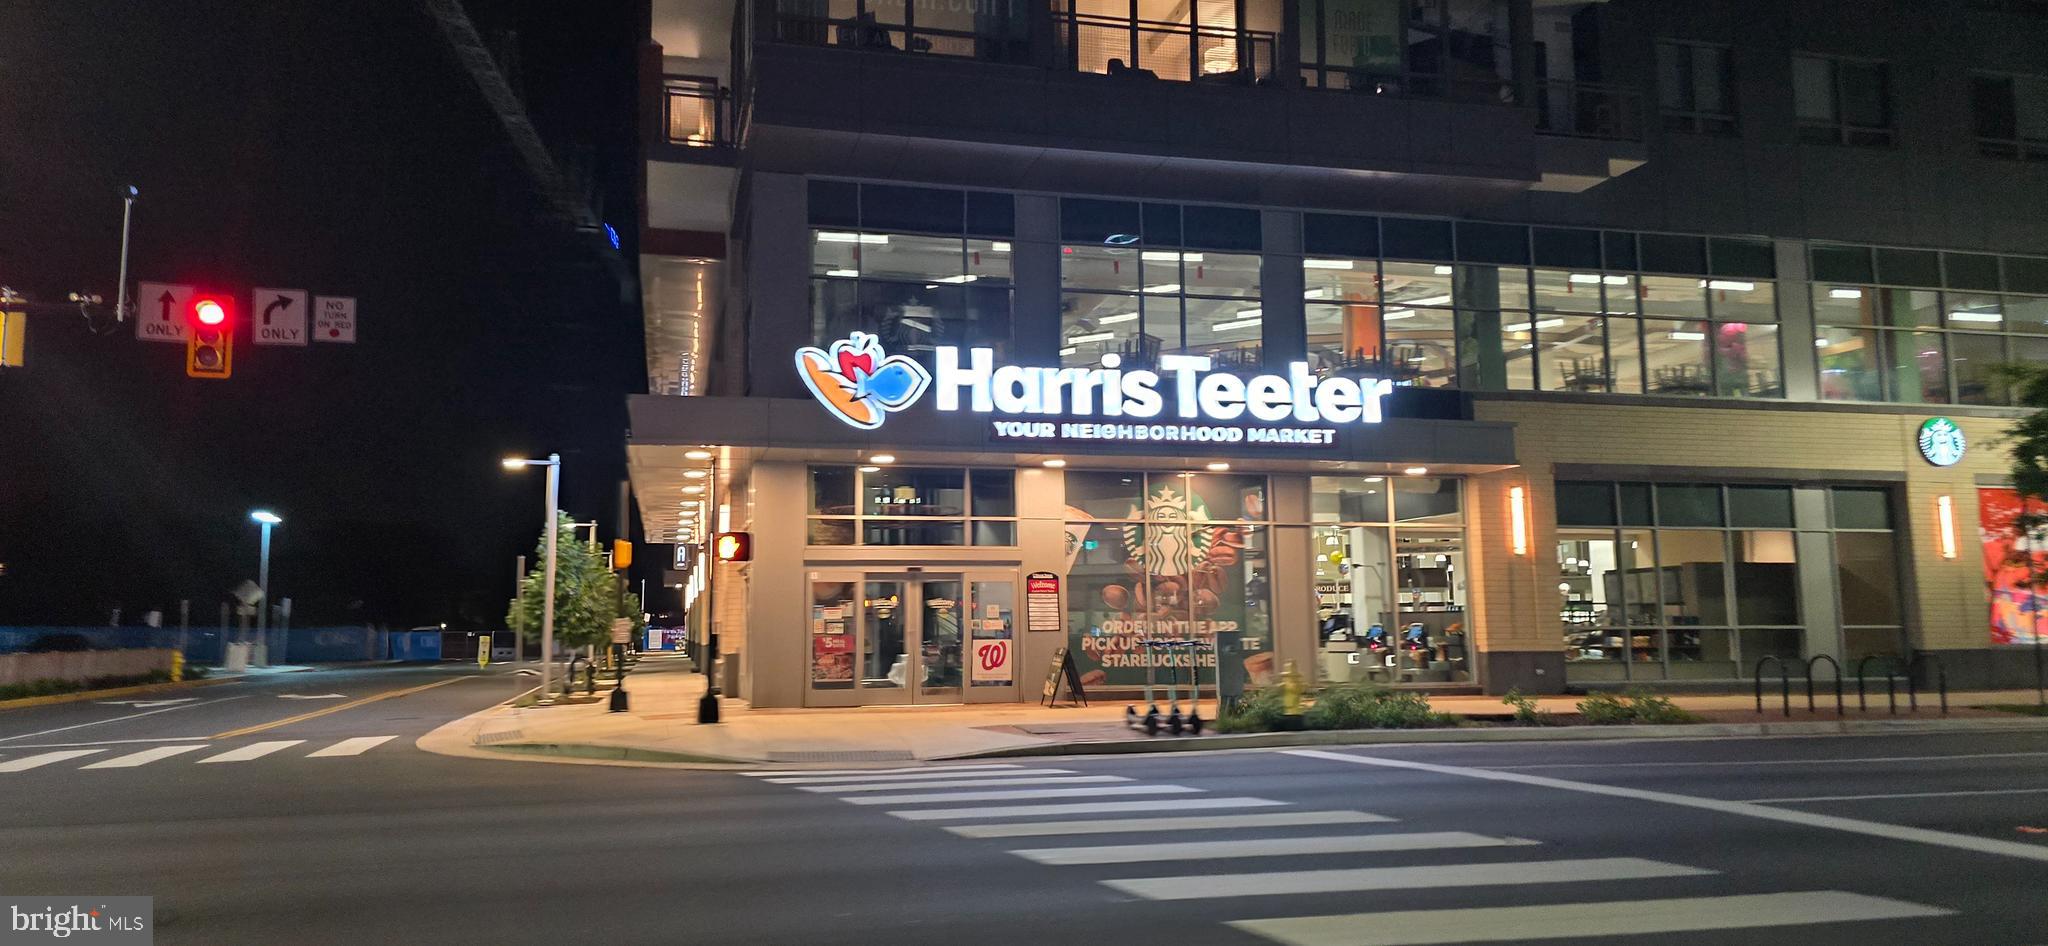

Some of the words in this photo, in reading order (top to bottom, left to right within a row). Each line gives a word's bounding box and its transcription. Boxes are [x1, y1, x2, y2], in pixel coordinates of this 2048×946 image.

[326, 301, 344, 310] NO
[324, 311, 347, 320] TURN
[146, 325, 183, 337] ONLY
[318, 320, 329, 328] ON
[334, 321, 352, 330] RED
[261, 327, 299, 340] ONLY
[936, 346, 1162, 418] Harris
[1161, 355, 1393, 424] Teeter
[993, 421, 1056, 438] YOUR
[1061, 423, 1244, 442] NEIGHBORHOOD
[1247, 427, 1336, 444] MARKET
[1157, 620, 1173, 634] IN
[1208, 621, 1238, 633] APP
[1082, 637, 1117, 651] PICK
[1119, 637, 1142, 651] UP
[978, 640, 1007, 671] W
[1102, 654, 1191, 668] STARBUCKS
